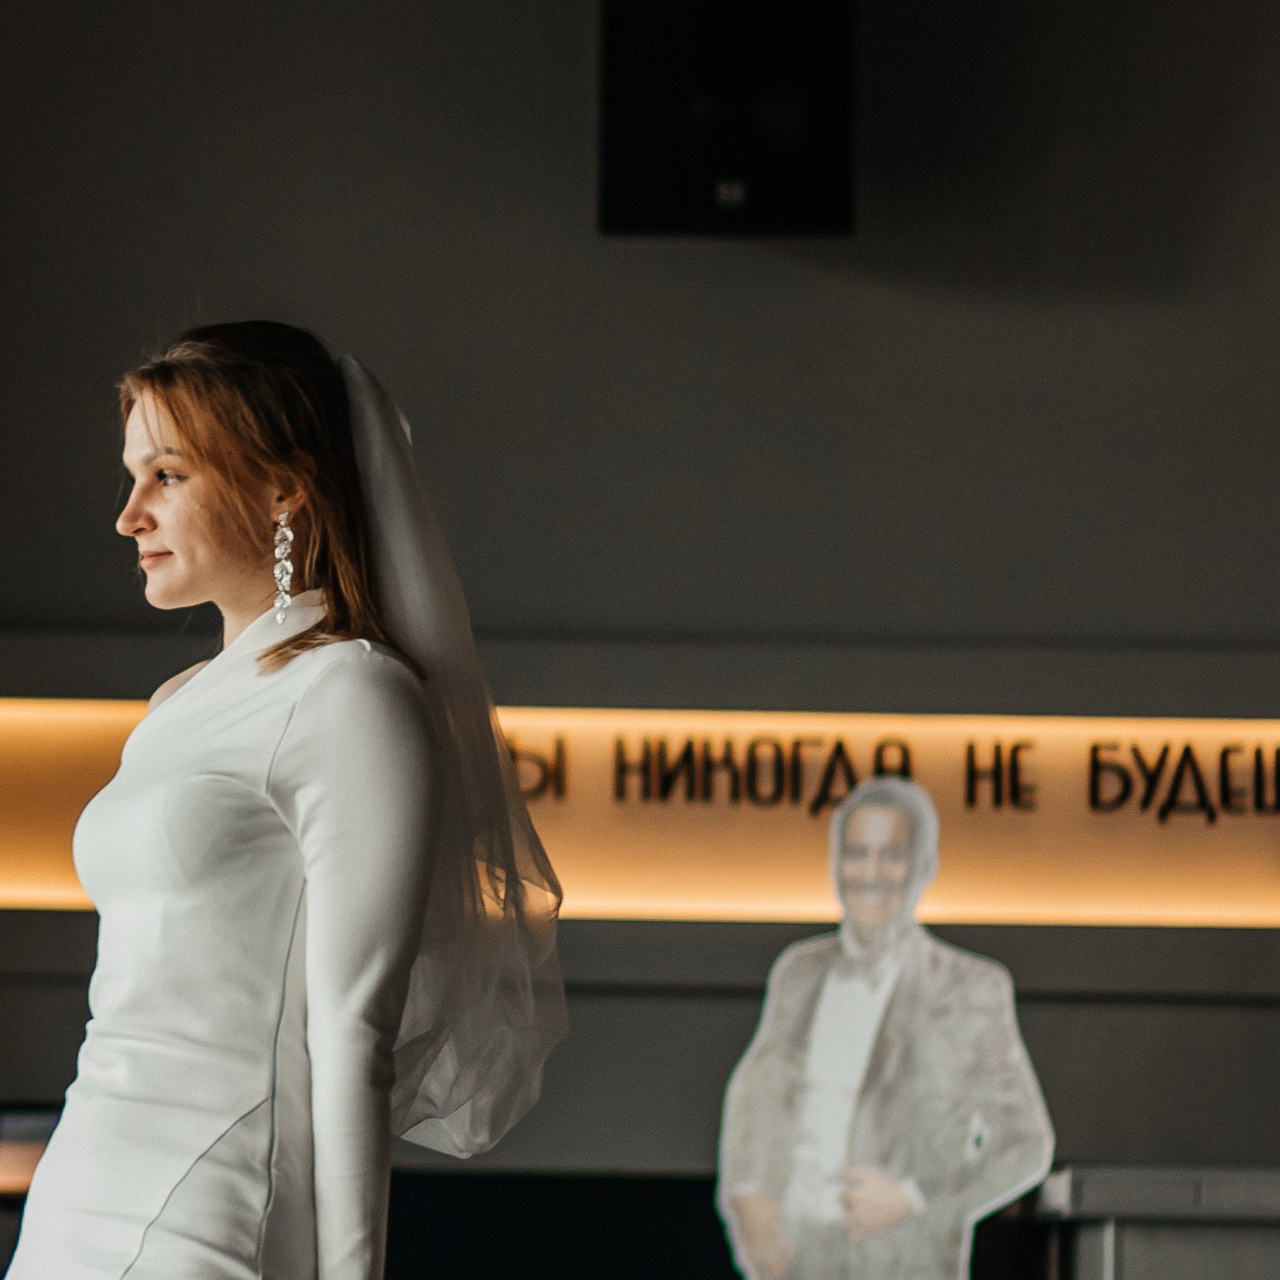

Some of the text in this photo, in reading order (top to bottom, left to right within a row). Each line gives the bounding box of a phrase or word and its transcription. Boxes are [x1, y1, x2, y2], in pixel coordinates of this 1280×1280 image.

[506, 737, 566, 803] Ы
[615, 737, 911, 815] НИКОГДА
[966, 741, 1037, 810] НЕ
